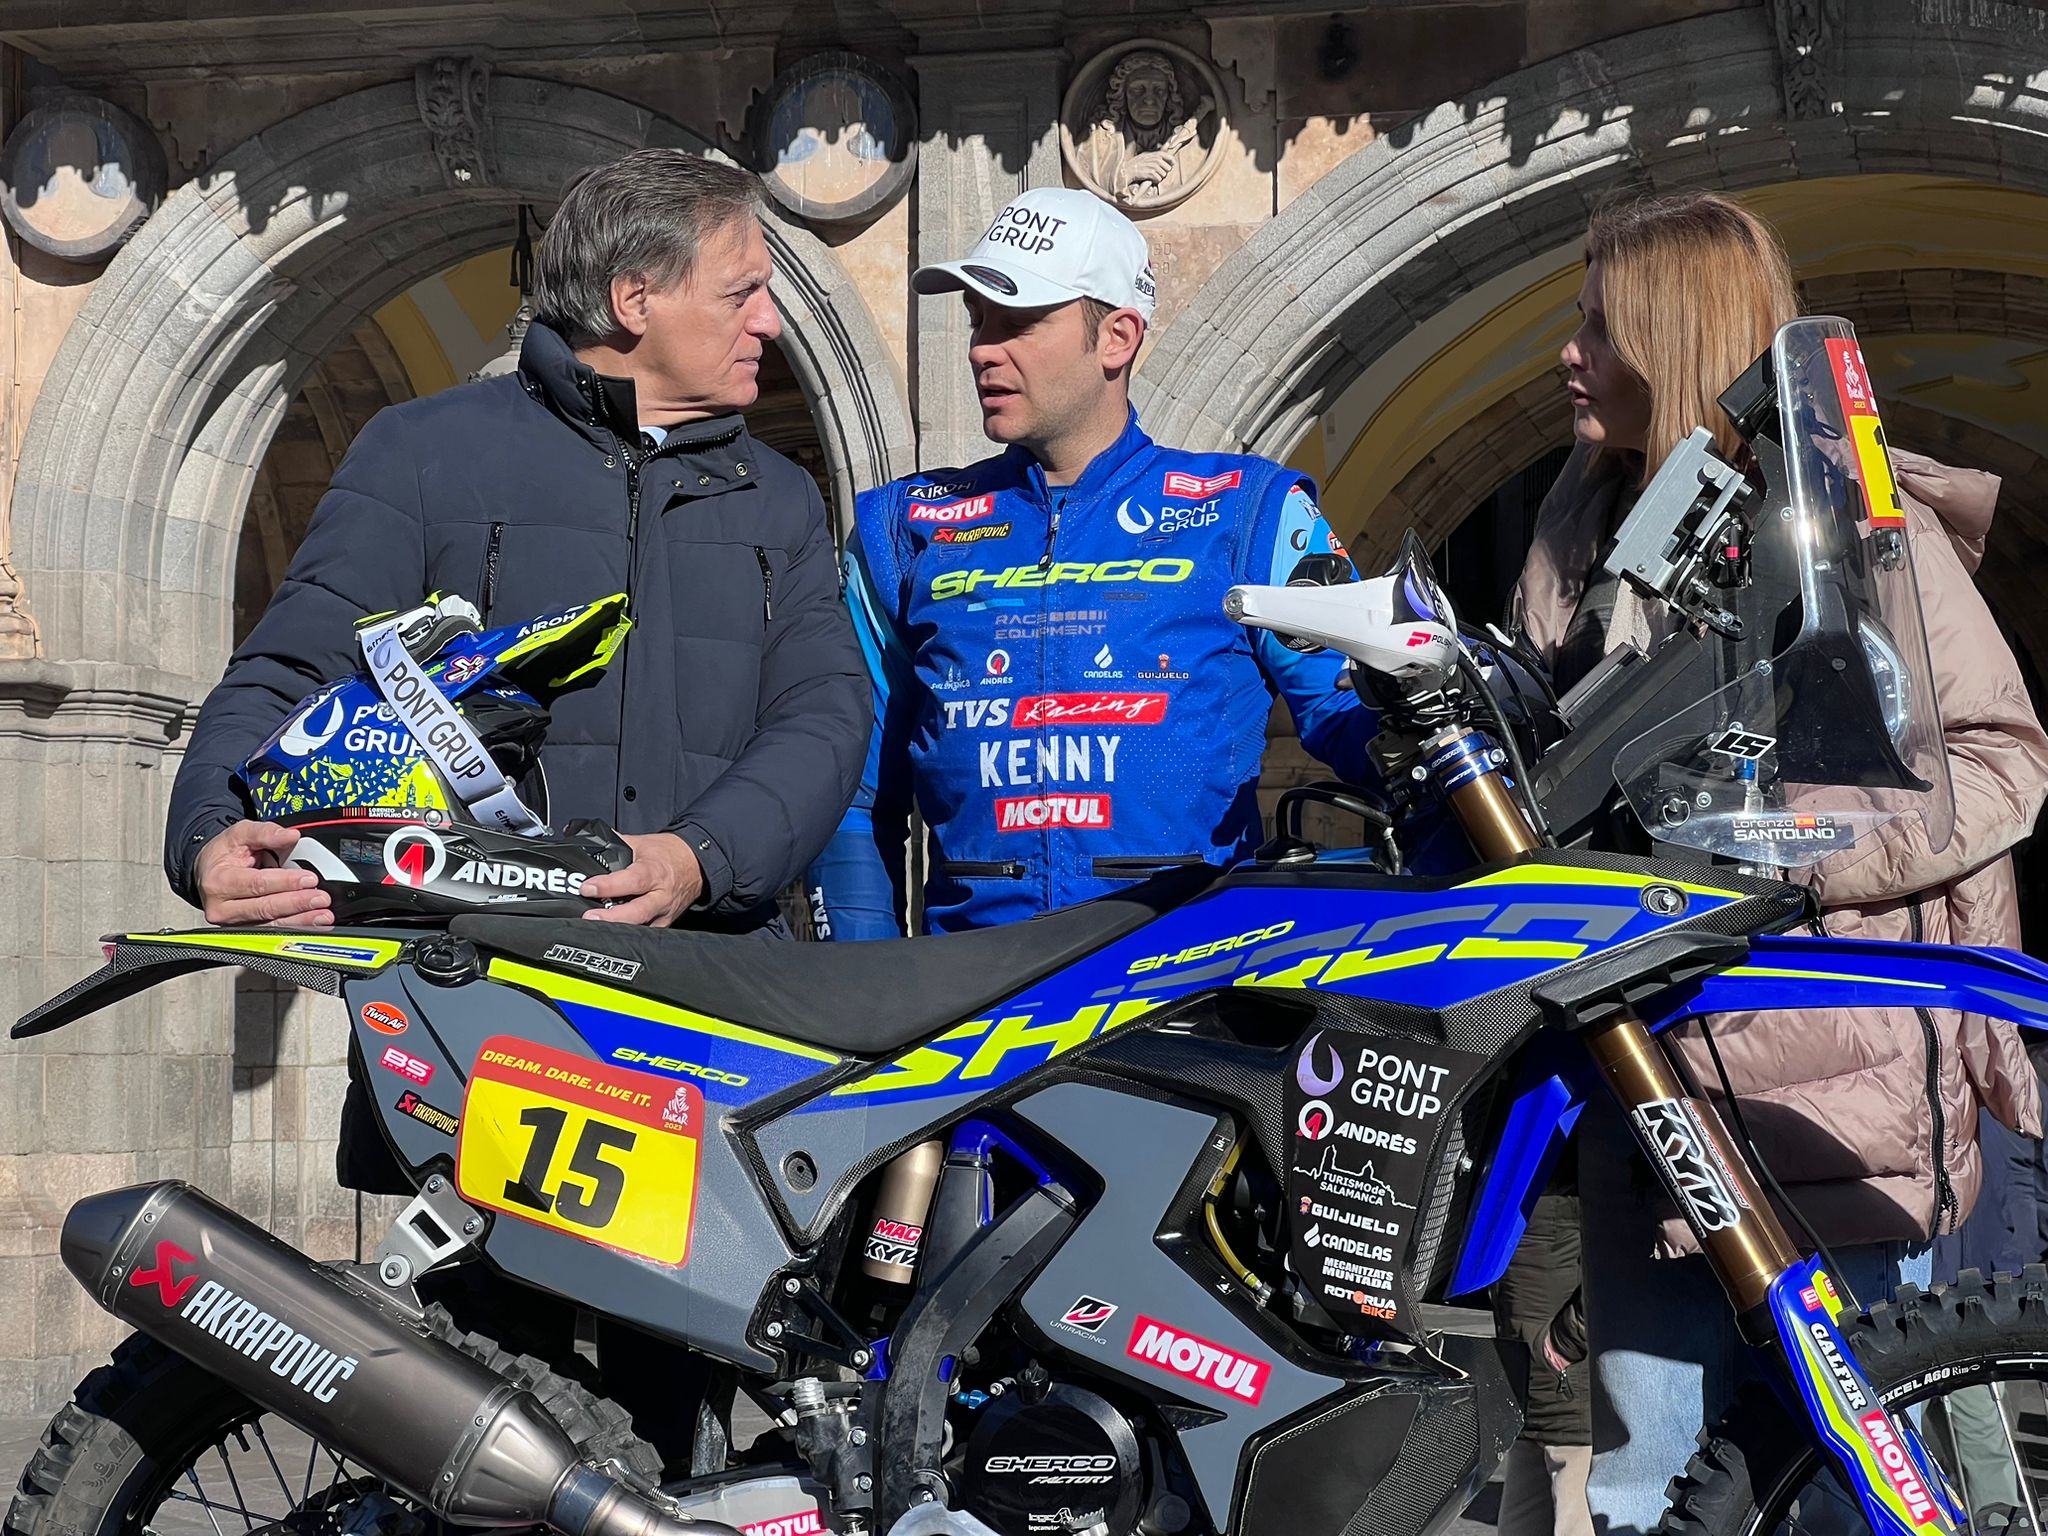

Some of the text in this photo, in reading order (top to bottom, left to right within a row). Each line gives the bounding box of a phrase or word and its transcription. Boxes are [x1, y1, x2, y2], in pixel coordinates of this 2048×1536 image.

[997, 206, 1068, 238] PONT
[987, 224, 1056, 256] GRUP
[910, 482, 972, 499] AIROH
[1169, 474, 1233, 492] BS
[912, 497, 989, 520] MOTUL
[1158, 512, 1220, 533] GRUP
[1160, 498, 1221, 521] PONT
[930, 557, 1194, 601] SHERCO
[516, 612, 576, 639] AIROH
[993, 612, 1050, 626] RACE
[993, 624, 1107, 641] EQUIPMENT
[1083, 670, 1123, 679] CANDELAS
[1137, 671, 1190, 680] GUIJUELO
[383, 661, 445, 728] PONT
[427, 721, 486, 781] GRUP
[943, 695, 1161, 729] TVS Racing
[979, 735, 1121, 788] KENNY
[1001, 797, 1105, 829] MOTUL
[1733, 819, 1795, 829] Lorenzo
[1733, 828, 1836, 841] SANTOLINO
[451, 860, 588, 897] ANDRÉS
[809, 886, 832, 941] TVS
[1126, 920, 1296, 976] SHERCO
[363, 1006, 406, 1031] Twin Air
[383, 1047, 430, 1078] BS
[610, 1046, 750, 1089] SHERCO
[1356, 1048, 1450, 1093] PONT
[480, 1049, 653, 1108] DREAM. DARE. LIVE IT.
[1350, 1078, 1441, 1120] GRUP
[661, 1108, 689, 1127] DAKAR
[663, 1121, 684, 1132] 2023
[1334, 1120, 1418, 1155] ANDRÉS
[502, 1106, 638, 1229] 15
[1636, 1097, 1741, 1232] KYB
[1319, 1181, 1384, 1207] SALAMANCA
[873, 1219, 922, 1242] MAC
[1310, 1202, 1400, 1236] GUIJUELO
[1321, 1232, 1393, 1263] CANDELAS
[1321, 1265, 1393, 1291] MUNTADA
[1323, 1256, 1394, 1281] MECANITZATS
[1323, 1283, 1398, 1311] ROTORUA
[1360, 1304, 1397, 1320] BIKE
[1049, 1319, 1107, 1345] UNIRACING
[1132, 1324, 1259, 1399] MOTUL
[1810, 1323, 1867, 1410] GALFER
[1878, 1364, 1978, 1406] EXCEL A60 Rim
[985, 1455, 1117, 1472] SHERCO
[1863, 1418, 1931, 1520] MOTUL
[1028, 1475, 1114, 1485] FACTORY
